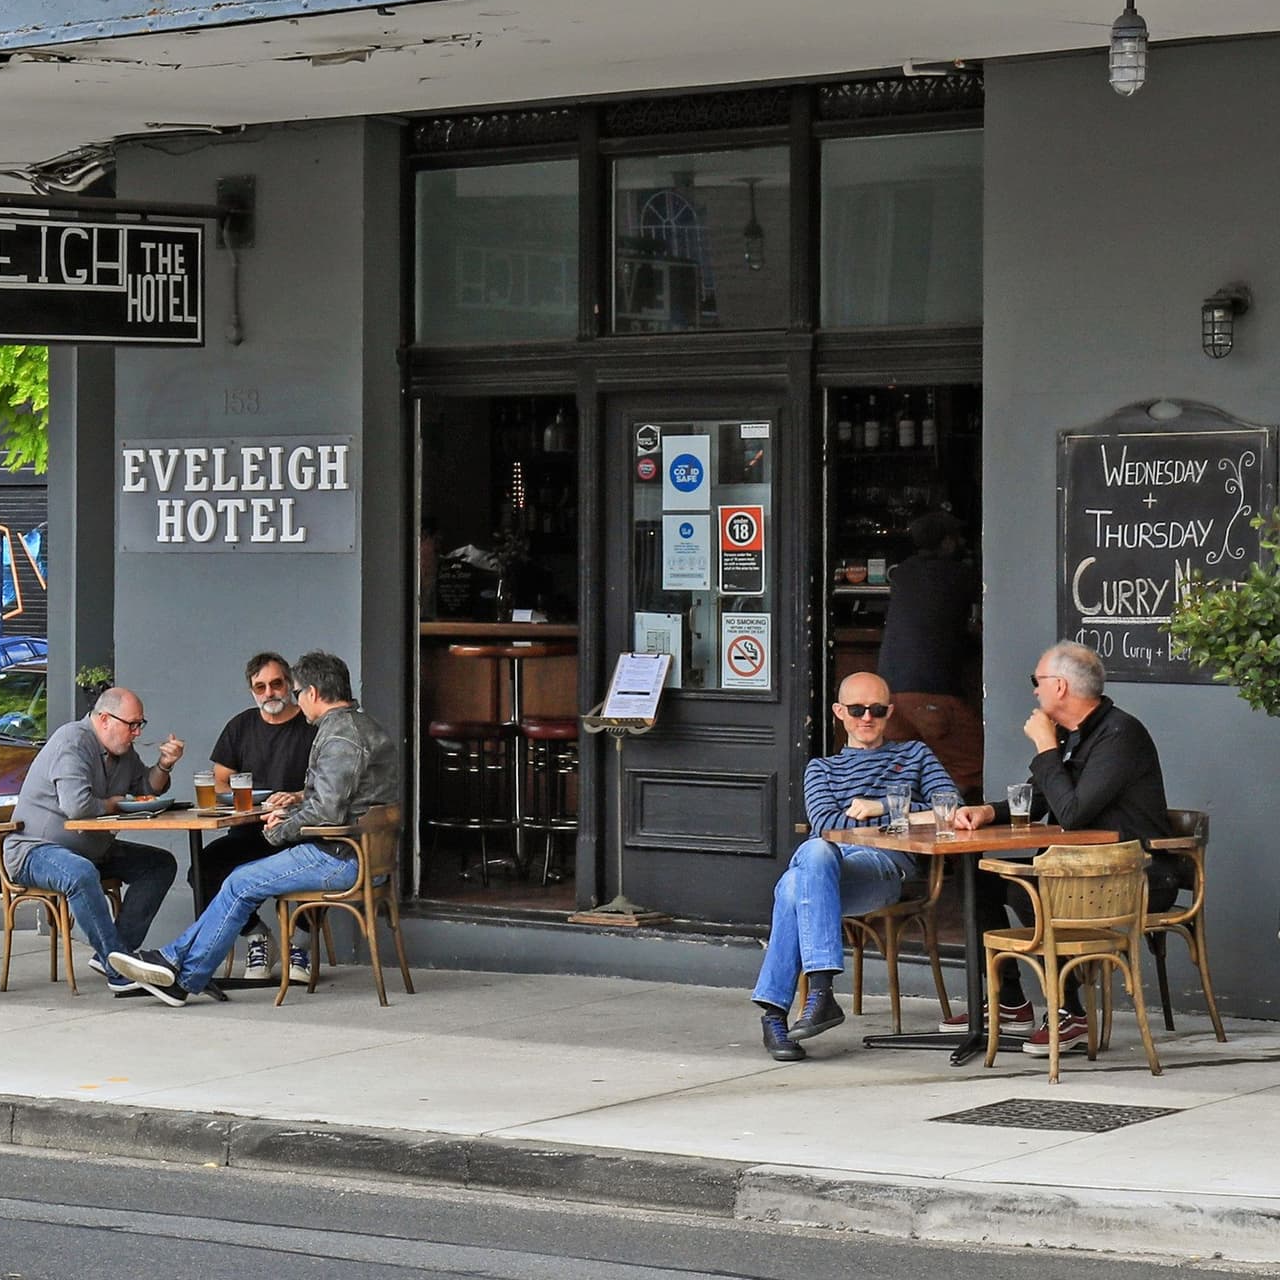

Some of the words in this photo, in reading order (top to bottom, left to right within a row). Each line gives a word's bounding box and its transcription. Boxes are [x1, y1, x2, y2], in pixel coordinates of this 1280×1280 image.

[140, 242, 185, 275] THE
[128, 274, 197, 323] HOTEL
[122, 445, 350, 492] EVELEIGH
[1101, 444, 1209, 487] WEDNESDAY
[157, 498, 307, 543] HOTEL
[732, 524, 749, 540] 18
[1085, 509, 1214, 549] THURSDAY
[1072, 557, 1169, 616] CURRY
[1122, 632, 1153, 666] Curry
